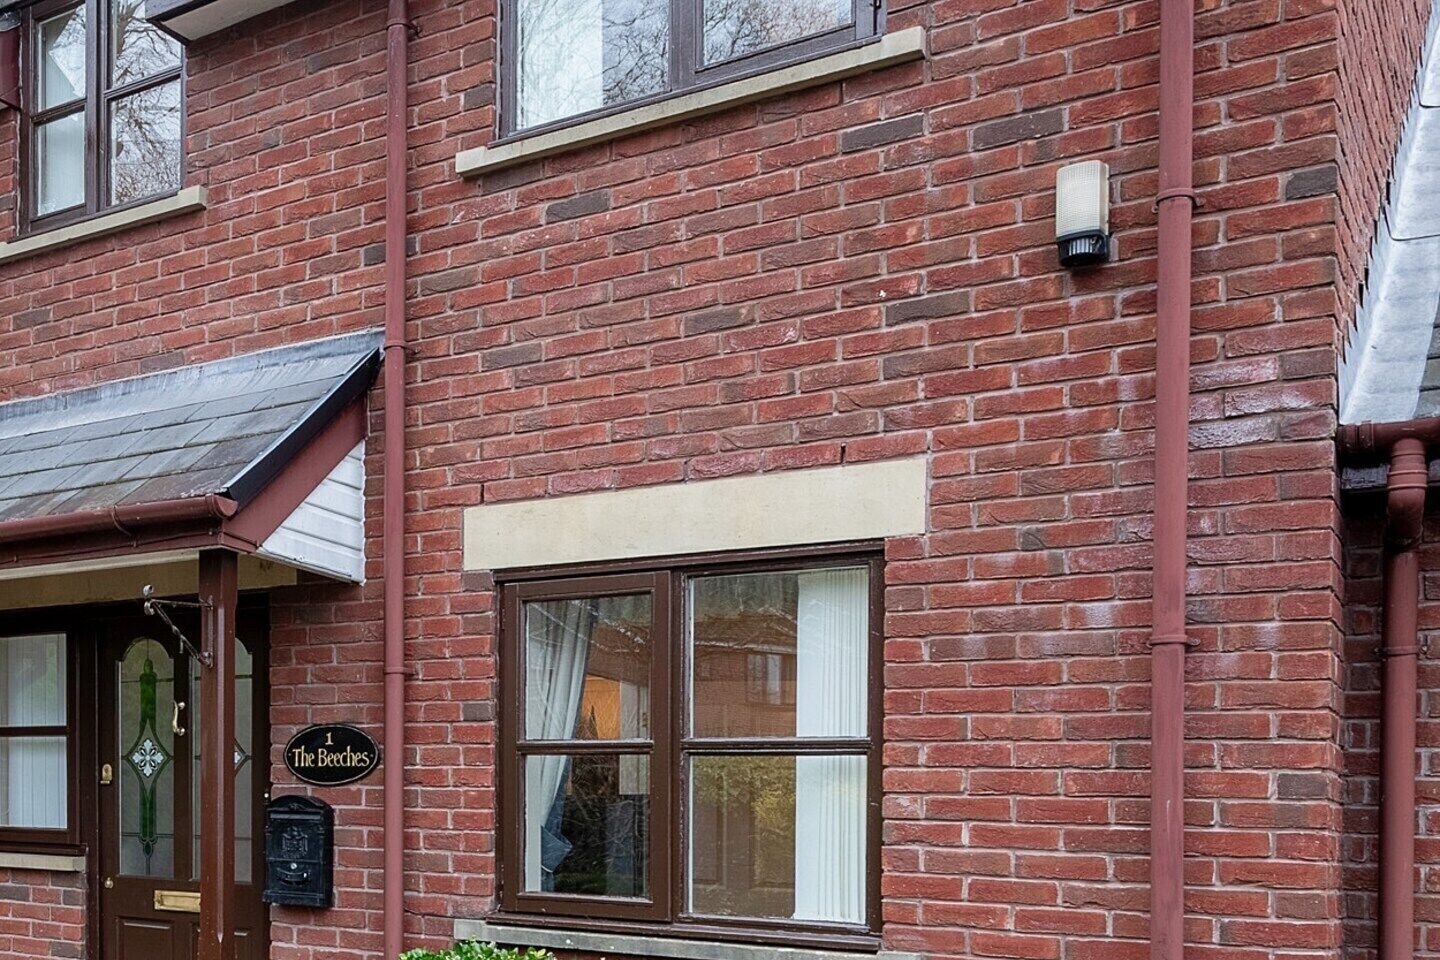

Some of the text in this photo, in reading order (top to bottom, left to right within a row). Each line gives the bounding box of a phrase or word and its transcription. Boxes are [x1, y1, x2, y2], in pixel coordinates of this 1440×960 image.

[324, 732, 334, 746] 1
[292, 745, 370, 767] The Beeches
